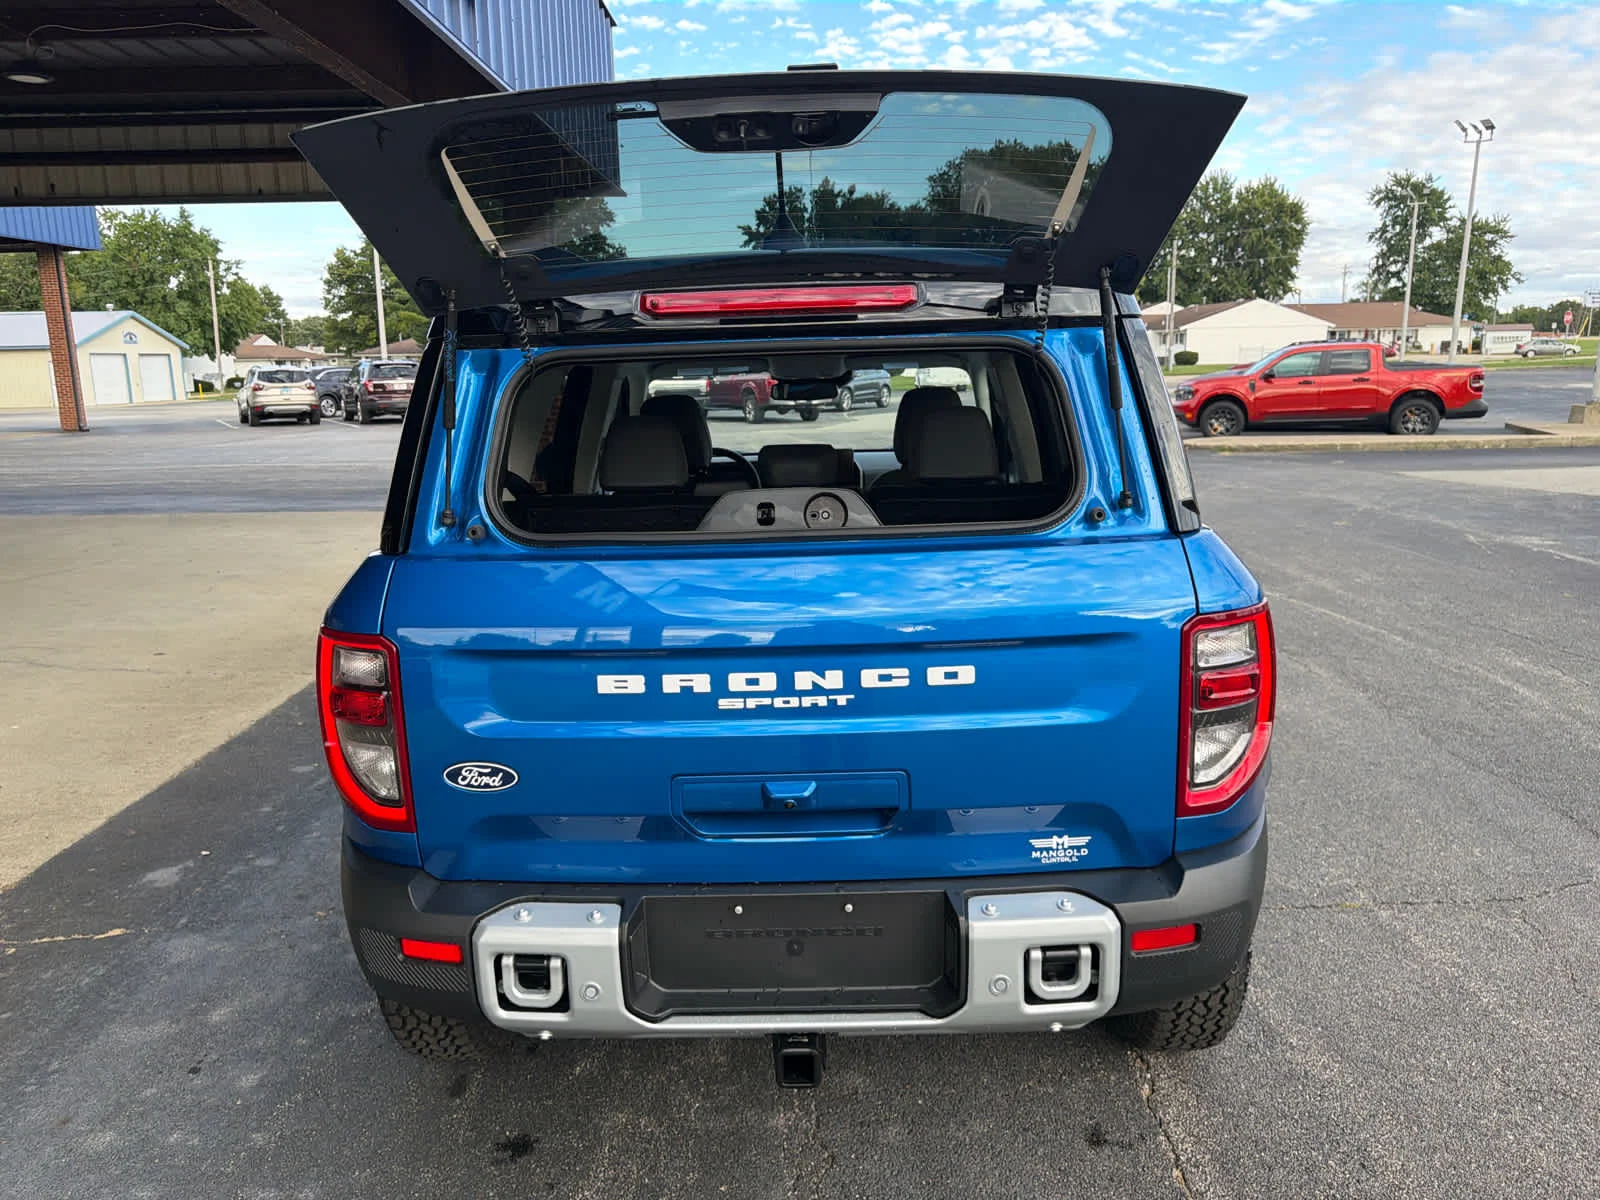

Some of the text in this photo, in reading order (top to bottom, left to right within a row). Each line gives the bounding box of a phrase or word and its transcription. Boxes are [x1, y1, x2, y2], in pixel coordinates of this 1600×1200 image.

[597, 665, 977, 694] BRONCO
[718, 694, 855, 709] SPORT
[458, 766, 503, 786] Ford
[1031, 848, 1089, 858] MANGOLD
